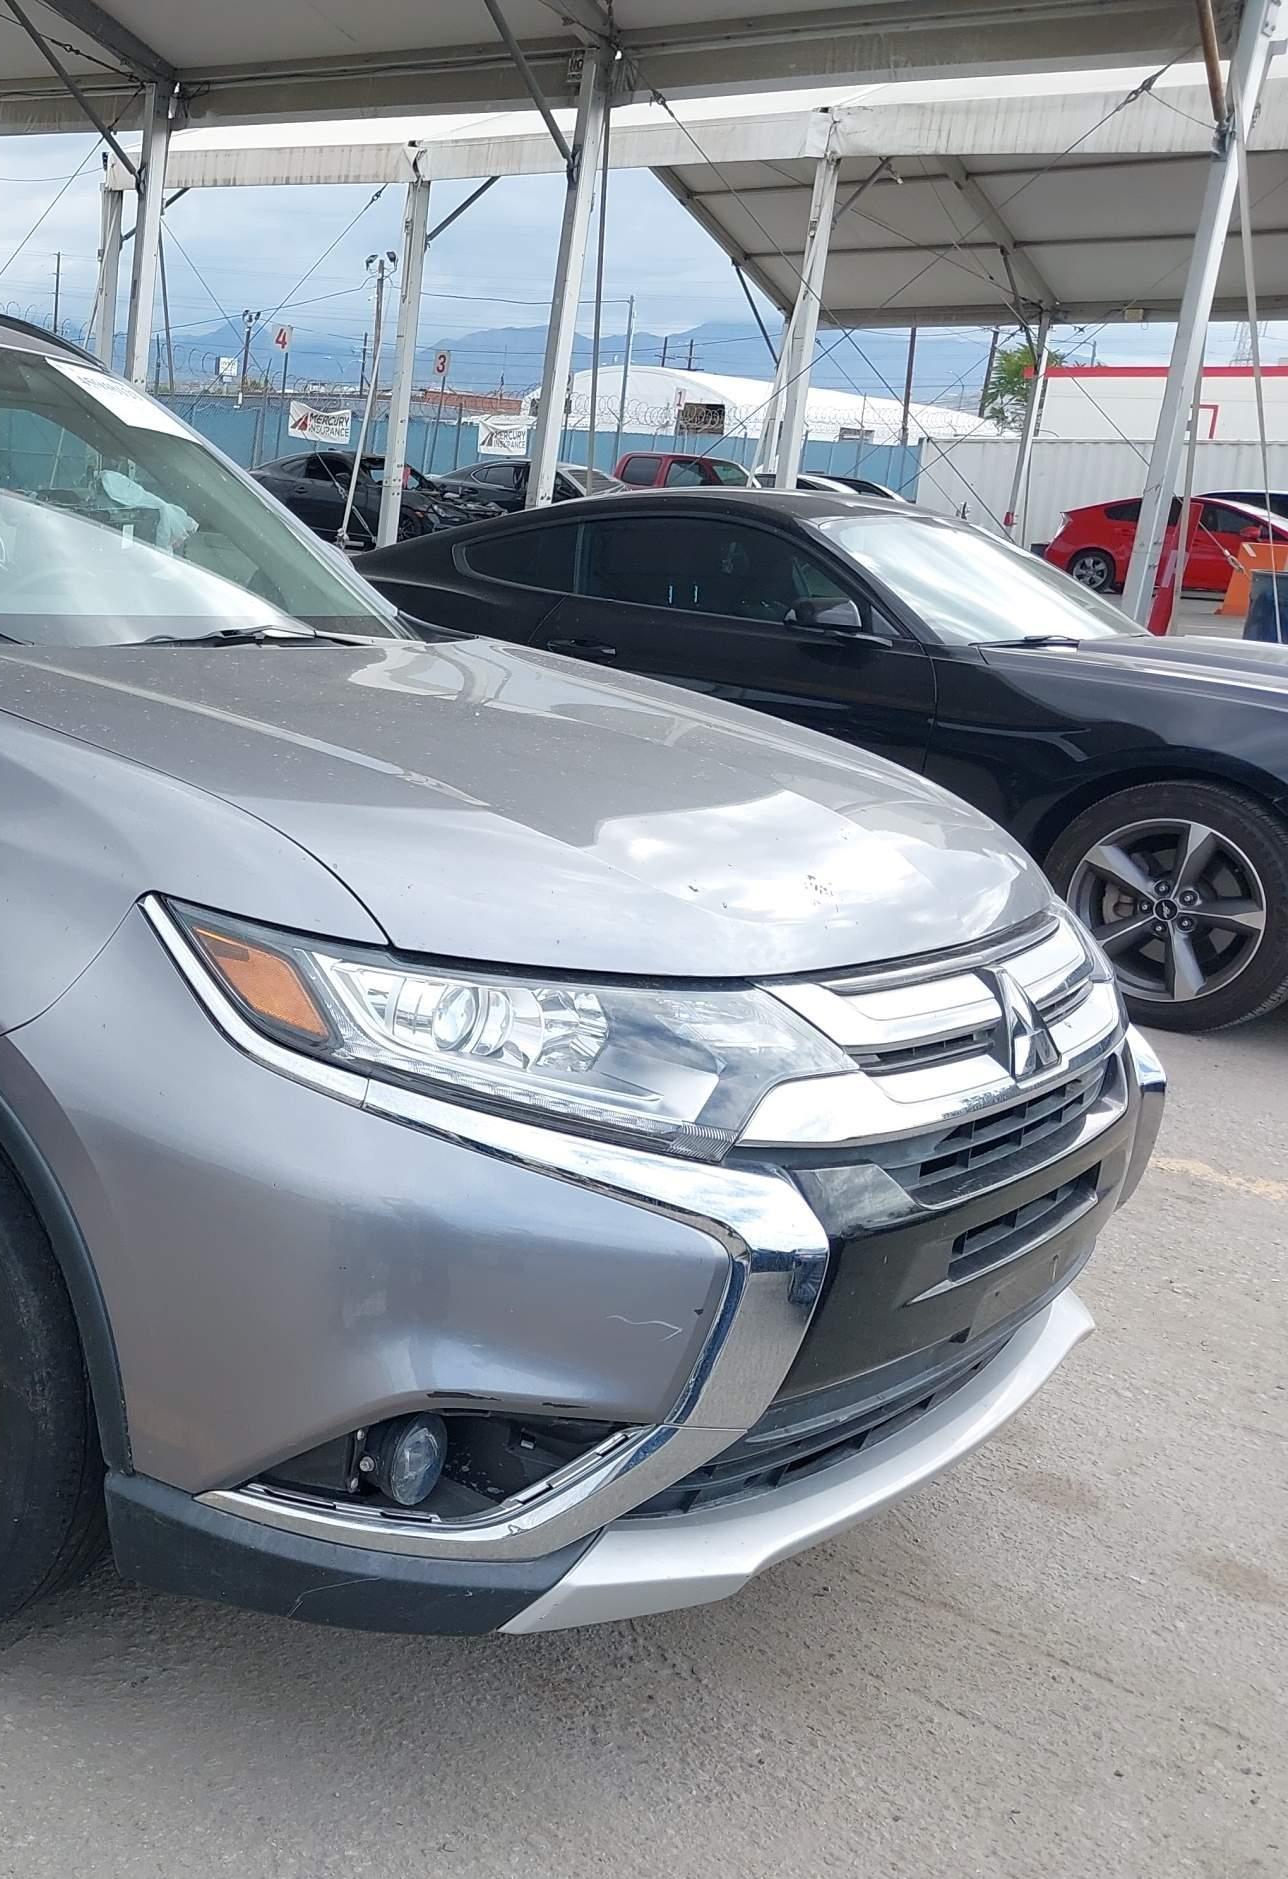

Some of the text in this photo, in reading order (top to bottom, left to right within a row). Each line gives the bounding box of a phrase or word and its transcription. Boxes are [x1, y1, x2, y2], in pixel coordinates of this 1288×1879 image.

[275, 328, 287, 349] 4
[436, 354, 447, 373] 3
[309, 412, 350, 427] MERCURY
[308, 424, 350, 437] INSURANCE
